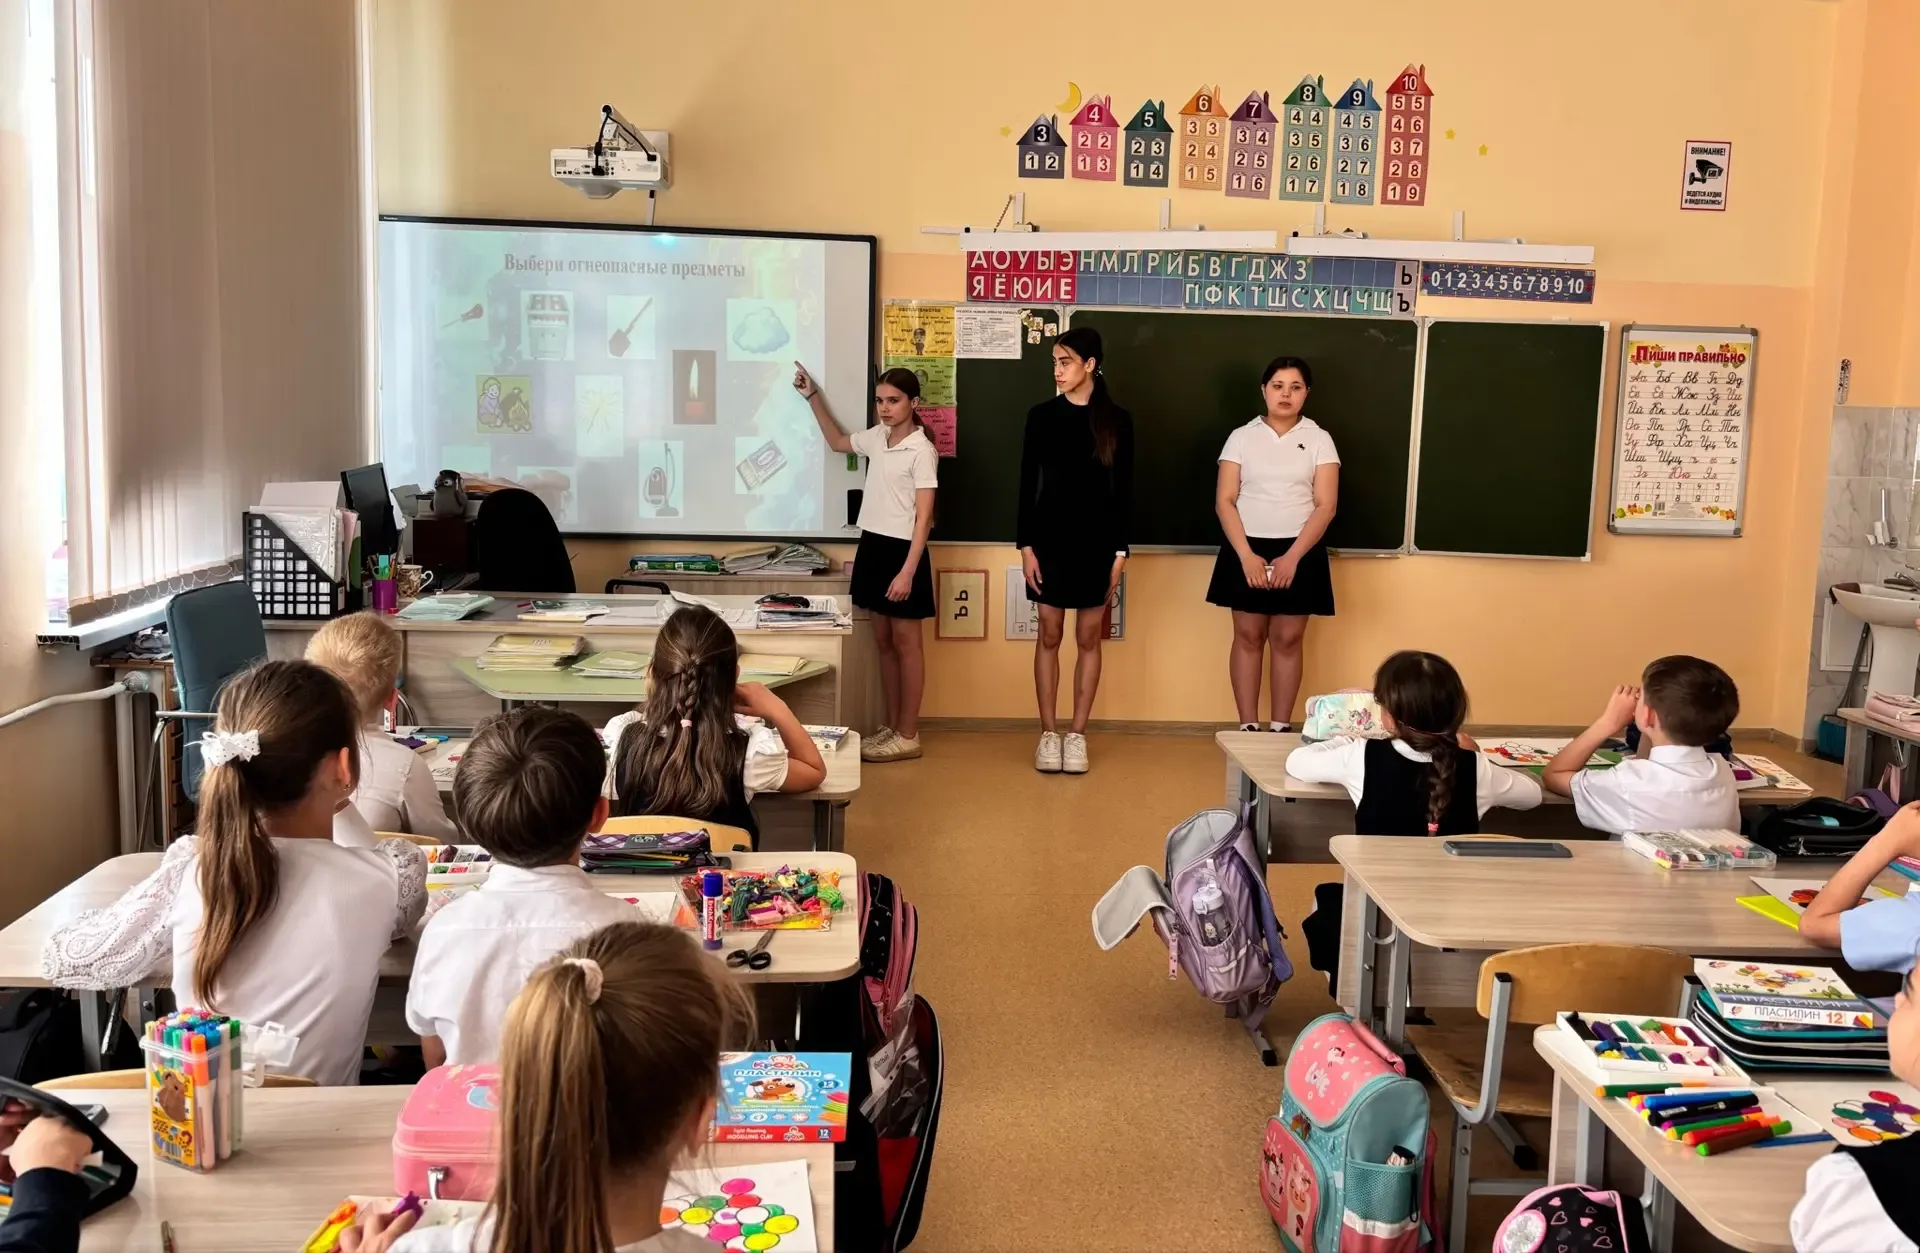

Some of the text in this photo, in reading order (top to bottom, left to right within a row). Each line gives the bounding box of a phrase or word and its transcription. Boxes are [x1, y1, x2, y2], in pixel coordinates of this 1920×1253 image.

[1403, 76, 1417, 90] 10
[1303, 86, 1313, 100] 8
[1353, 91, 1362, 104] 9
[1199, 94, 1208, 111] 6
[1395, 97, 1422, 109] 5 5
[1089, 107, 1099, 121] 4
[1249, 103, 1258, 116] 7
[1144, 112, 1154, 126] 5
[1293, 111, 1320, 124] 4 4
[1343, 116, 1371, 128] 4 5
[1189, 122, 1216, 134] 3 3
[1394, 118, 1421, 131] 4 6
[1037, 127, 1047, 141] 3
[1239, 131, 1266, 144] 3 4
[1292, 134, 1319, 146] 3 5
[1081, 135, 1108, 147] 2 2
[1342, 138, 1369, 150] 3 6
[1393, 141, 1420, 154] 3 7
[1134, 142, 1162, 155] 2 3
[1188, 144, 1216, 157] 2 4
[1691, 147, 1726, 156] ВНИМАНИЕ!
[1028, 156, 1056, 168] 1 2
[1080, 158, 1107, 171] 1 3
[1237, 154, 1265, 167] 2 5
[1290, 157, 1318, 169] 2 6
[1340, 161, 1368, 173] 2 7
[1133, 165, 1161, 177] 1 4
[1188, 168, 1214, 180] 1 5
[1392, 164, 1419, 176] 2 8
[1235, 176, 1263, 189] 1 6
[1290, 179, 1317, 192] 1 7
[1340, 183, 1366, 196] 1 8
[1390, 187, 1417, 199] 1 9
[504, 254, 746, 280] Выбери огнеопасные предметы
[1755, 1007, 1820, 1019] ПЛАСТИЛИН
[1827, 1014, 1843, 1023] 12
